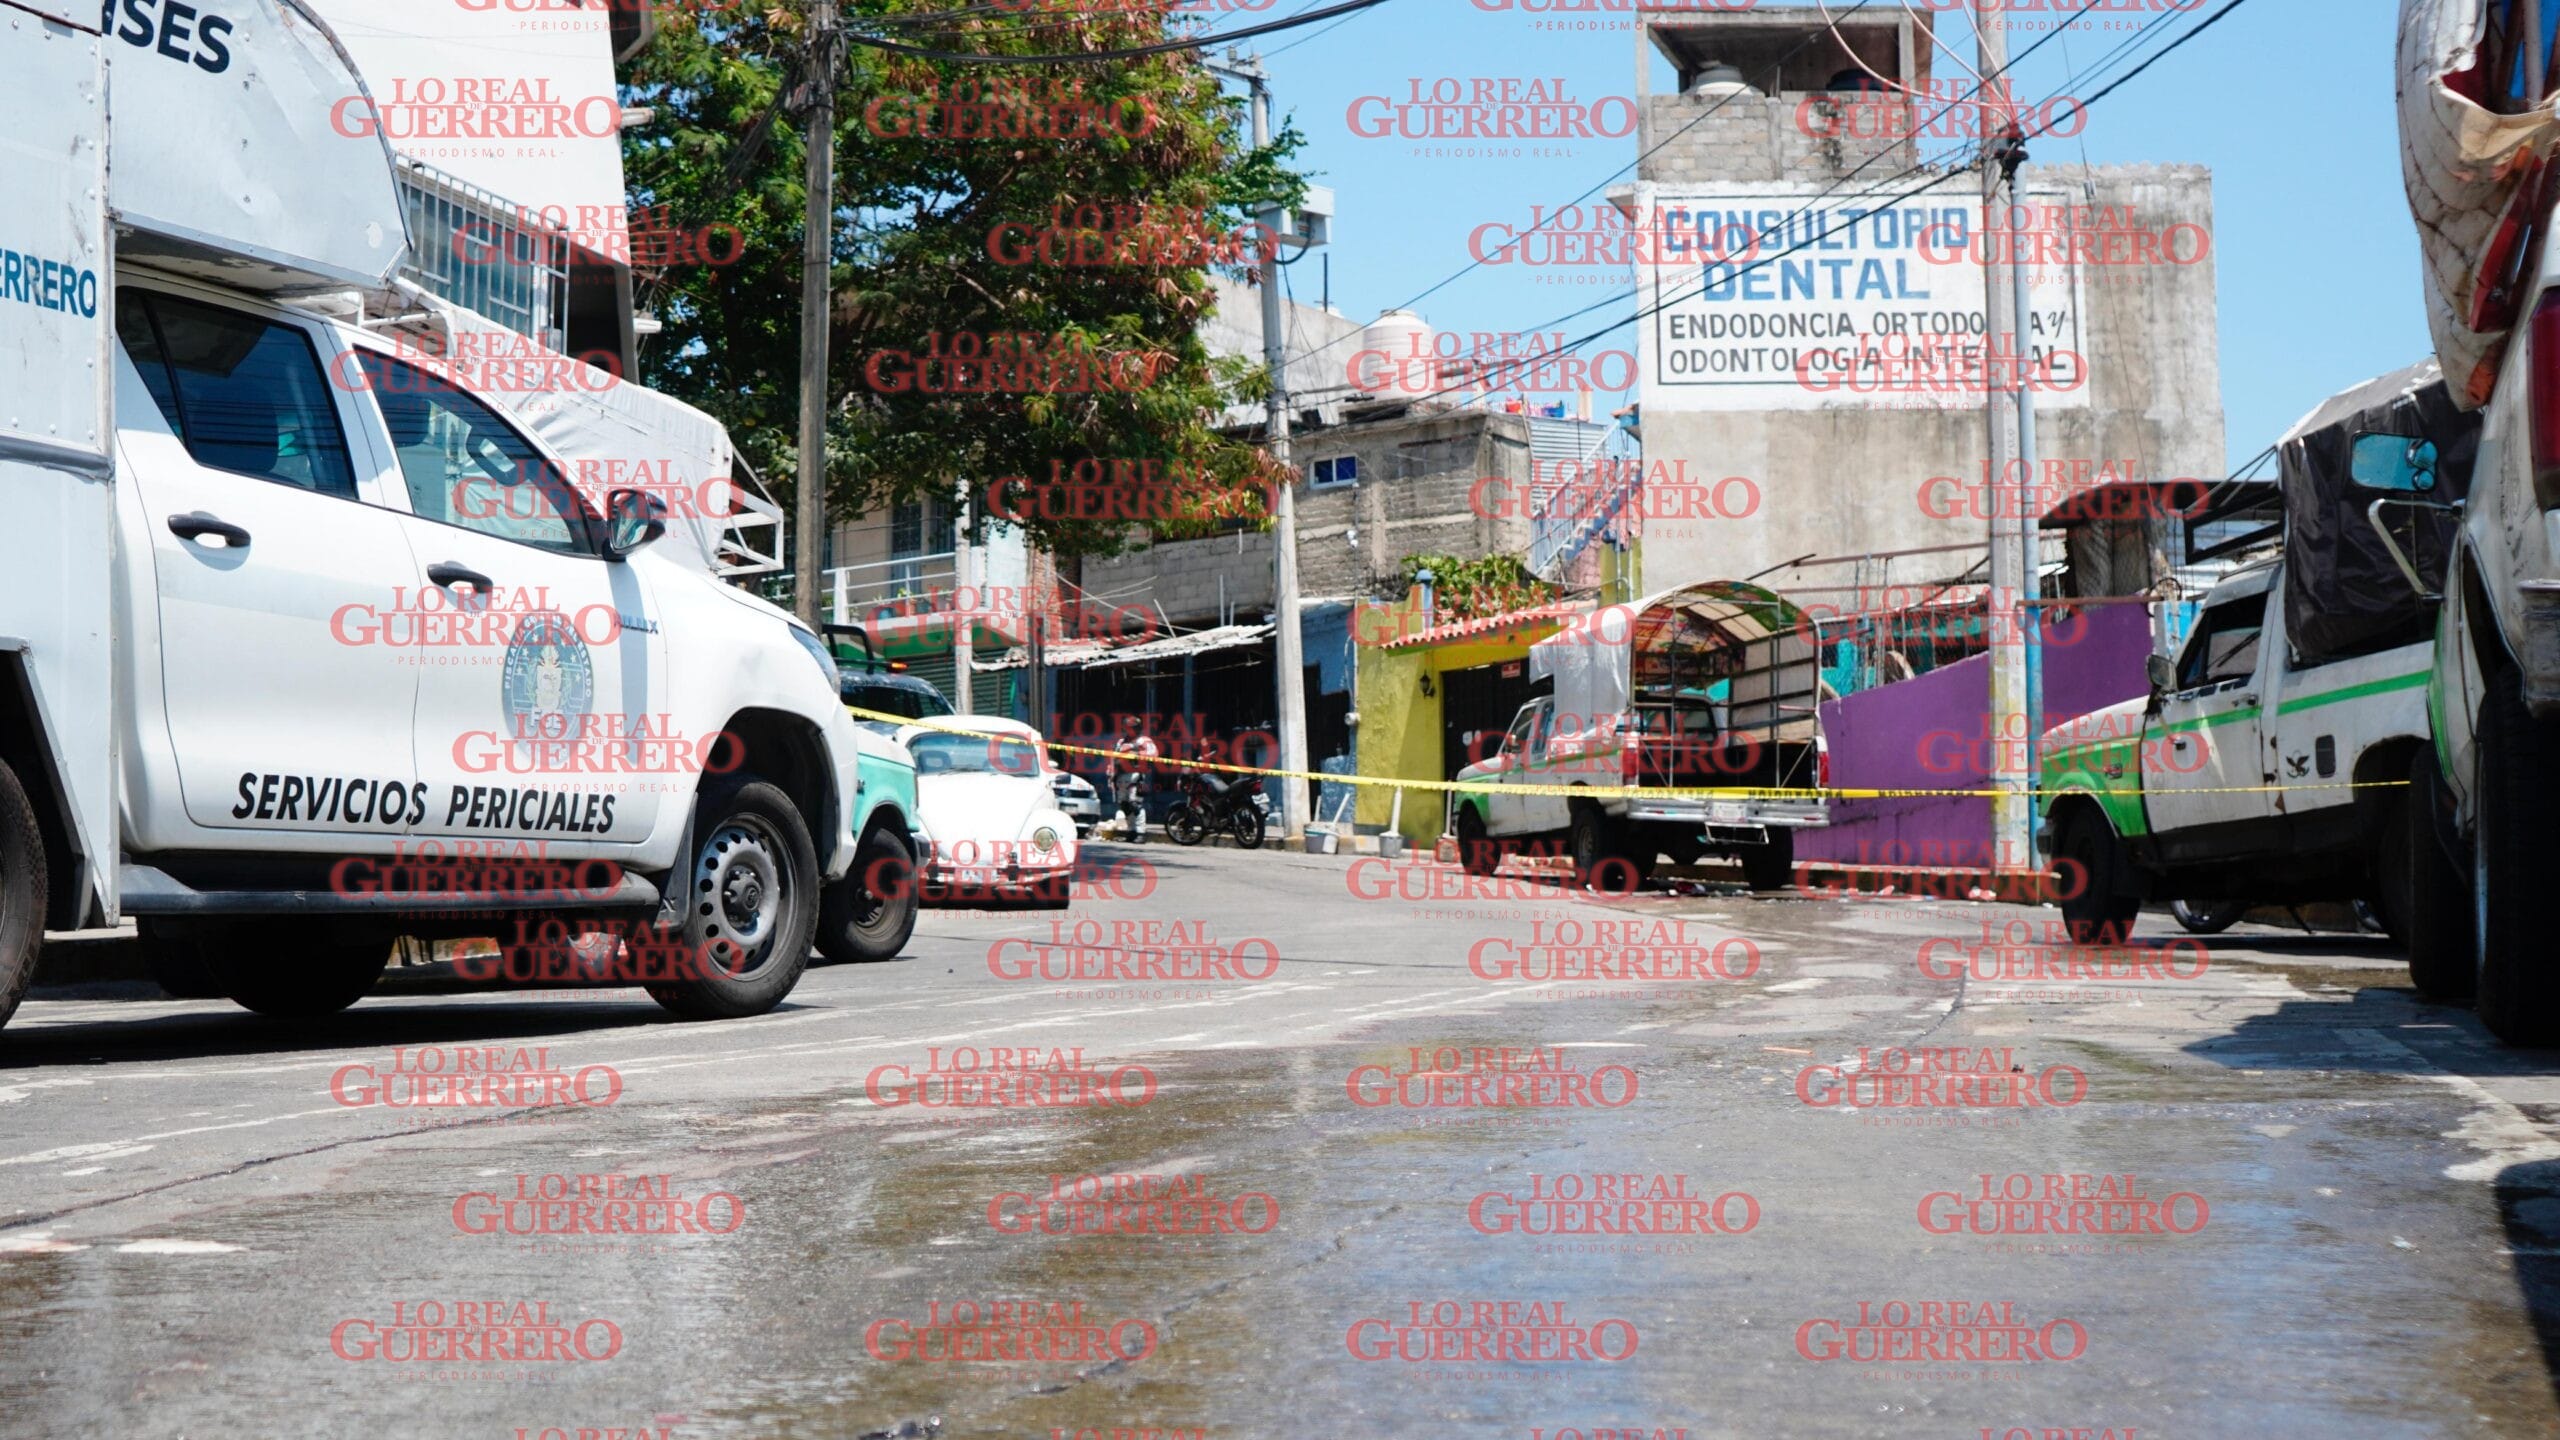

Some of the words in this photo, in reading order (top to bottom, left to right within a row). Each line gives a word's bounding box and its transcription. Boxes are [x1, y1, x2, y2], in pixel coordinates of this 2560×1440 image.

[1666, 207, 1969, 253] CONSULTORIO
[0, 247, 97, 319] RRERO
[1703, 257, 1931, 302] DENTAL
[1670, 346, 1884, 374] ODONTOLOGIA
[1903, 344, 2066, 370] INTEAL
[232, 772, 428, 826] SERVICIOS
[445, 785, 616, 834] PERICIALES
